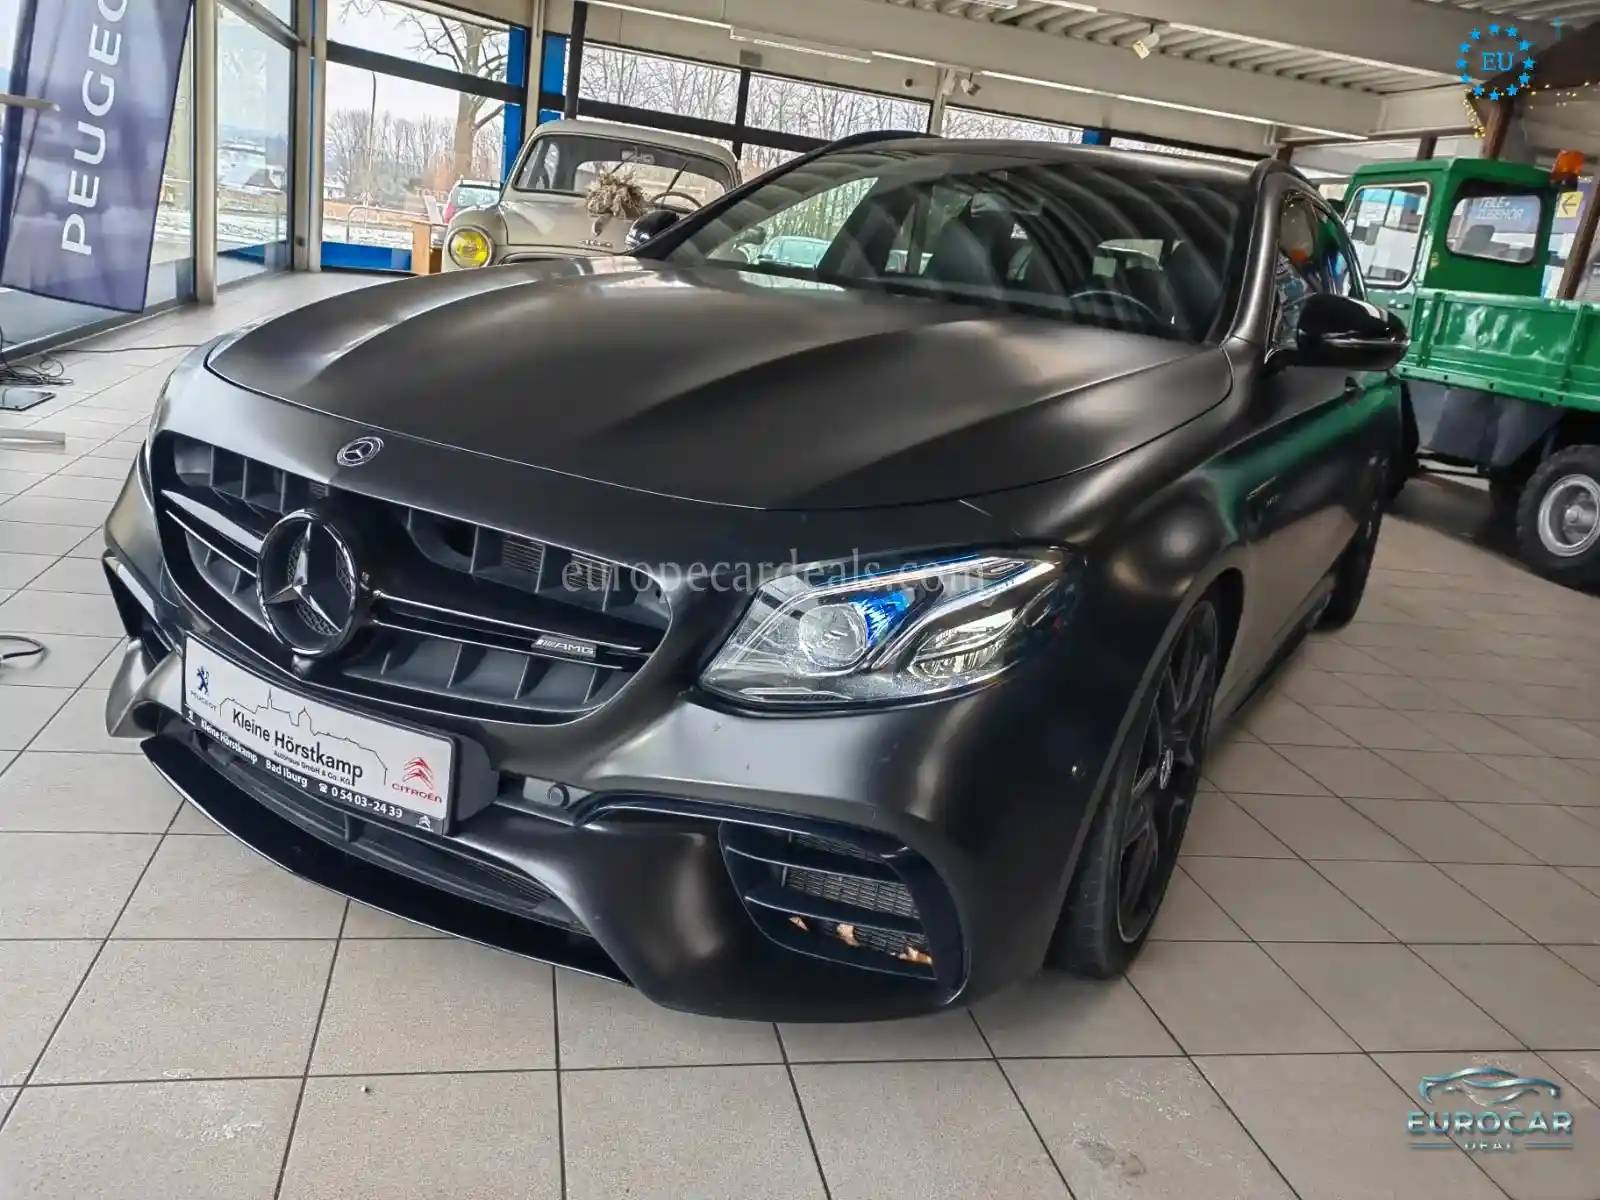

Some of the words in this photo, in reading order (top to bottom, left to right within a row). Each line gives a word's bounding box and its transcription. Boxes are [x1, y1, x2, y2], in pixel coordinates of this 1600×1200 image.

[200, 719, 220, 741] Kleine
[220, 732, 259, 765] Hörstkamp
[265, 759, 282, 775] Bad
[283, 767, 308, 788] Iburg
[232, 708, 271, 742] Kleine
[274, 730, 363, 787] Hörstkamp
